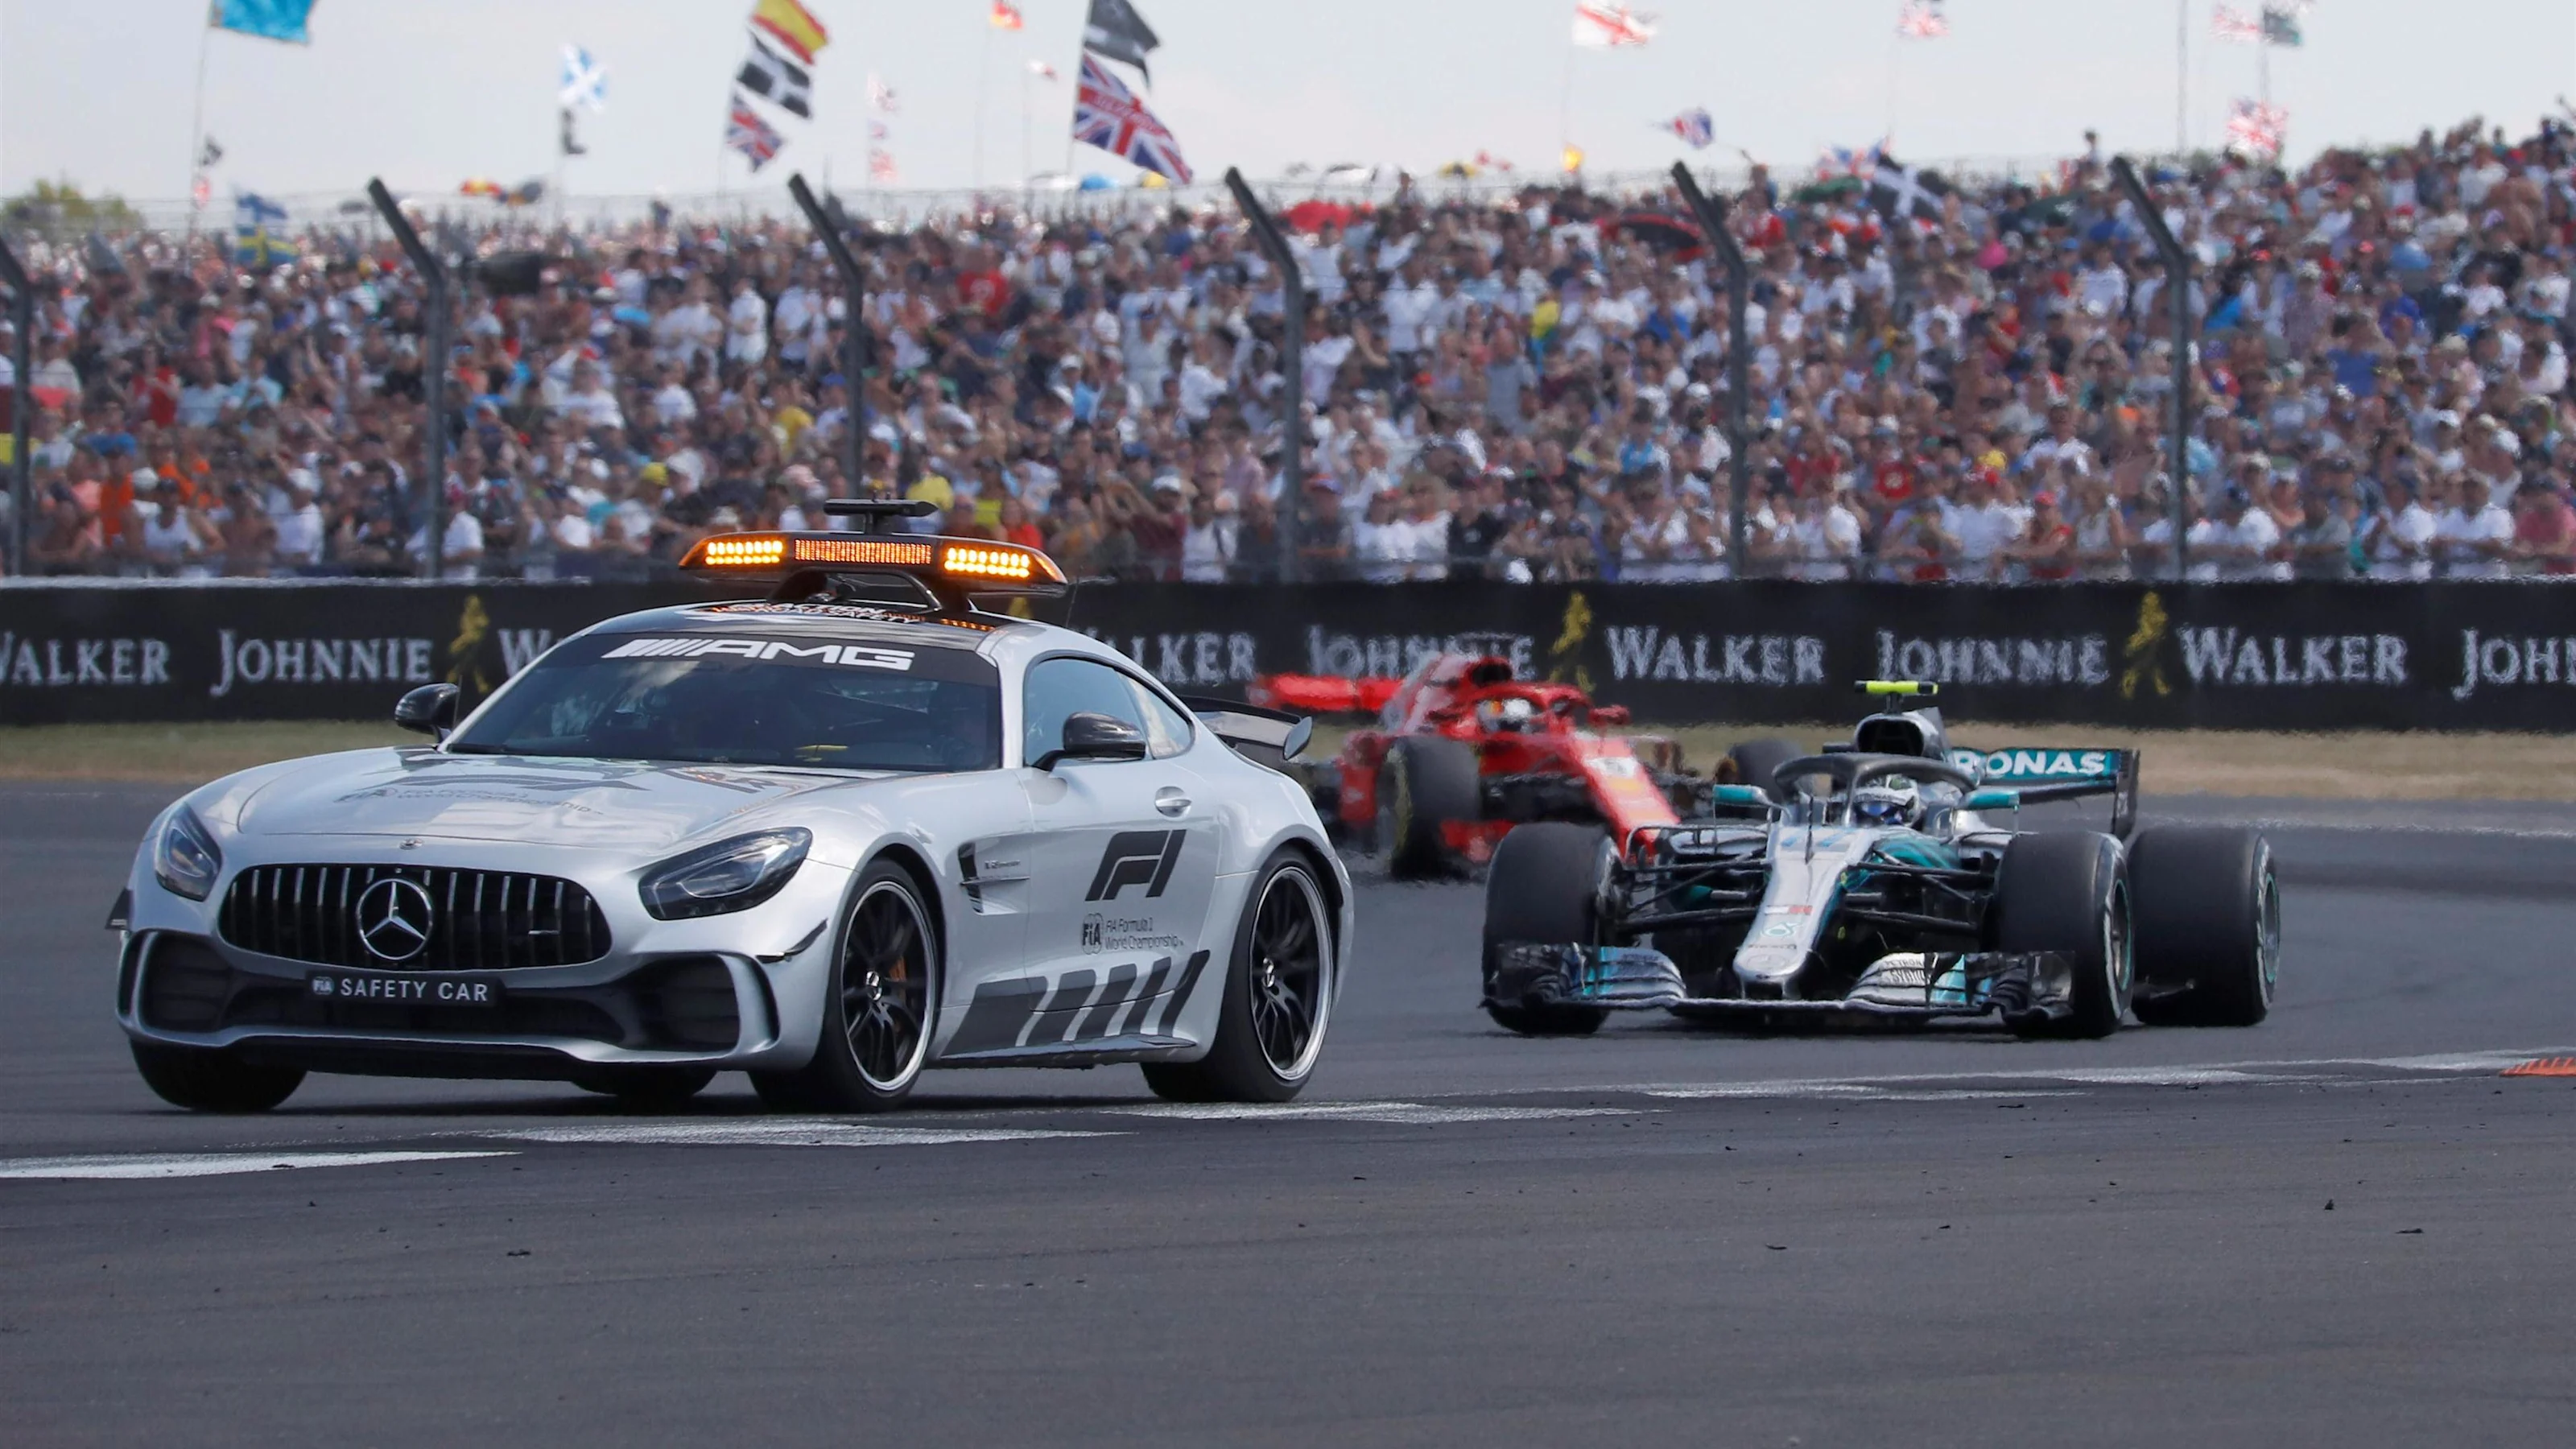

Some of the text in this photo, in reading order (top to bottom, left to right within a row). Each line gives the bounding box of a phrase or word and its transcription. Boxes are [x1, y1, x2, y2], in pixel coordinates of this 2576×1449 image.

[210, 630, 433, 697] JOHNNIE
[1604, 625, 2112, 687] WALKER JOHNNIE
[2175, 622, 2408, 686] WALKER
[1084, 829, 1187, 902] F1
[1082, 923, 1102, 946] FIA
[312, 978, 489, 1002] FIA SAFETY CAR
